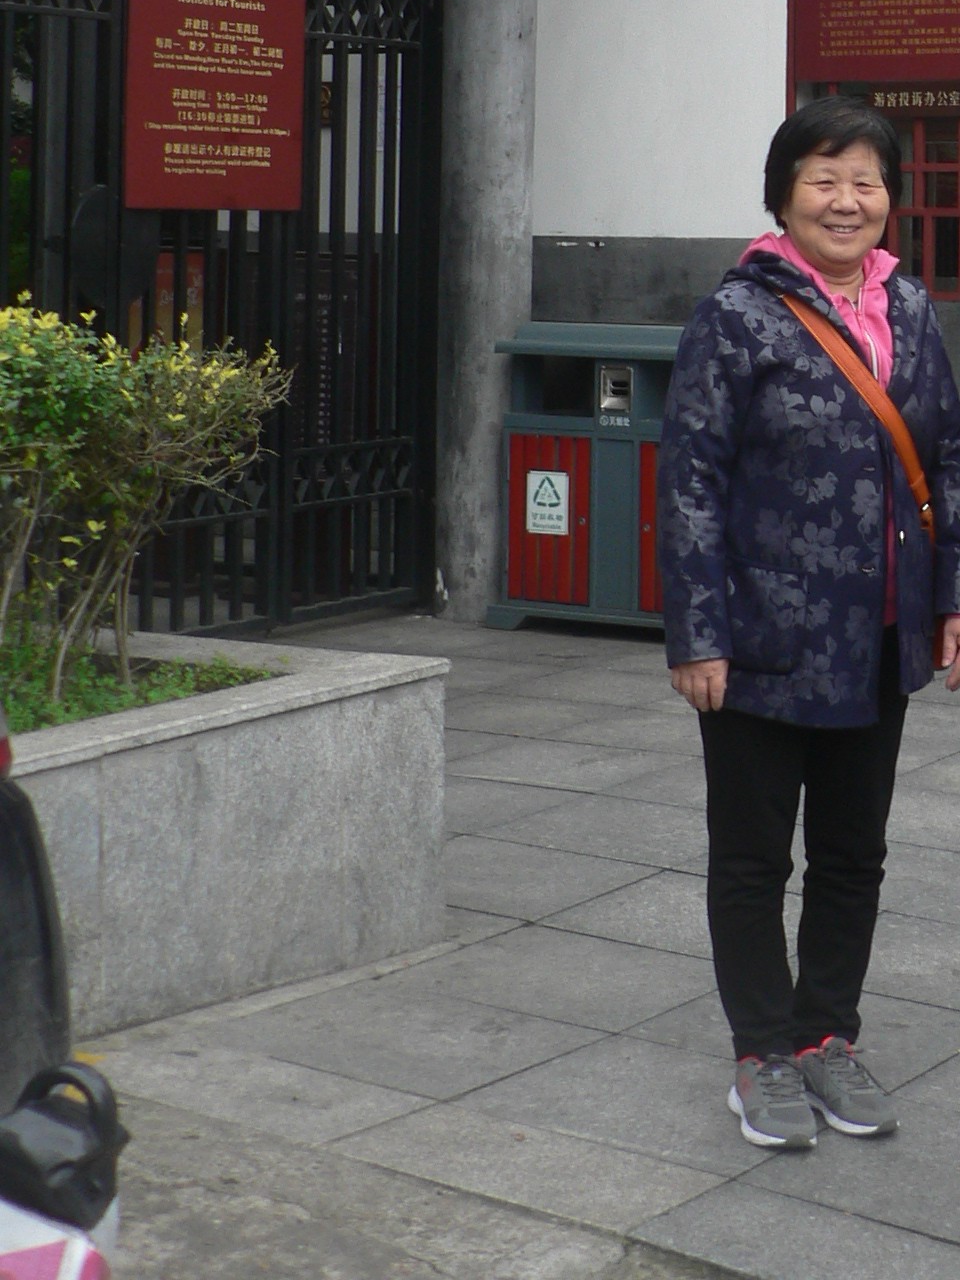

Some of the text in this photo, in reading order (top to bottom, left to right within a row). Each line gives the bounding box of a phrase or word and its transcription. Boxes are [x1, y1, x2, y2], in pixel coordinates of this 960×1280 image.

[229, 0, 266, 11] Tourists
[874, 91, 960, 108] 游客投诉办公室
